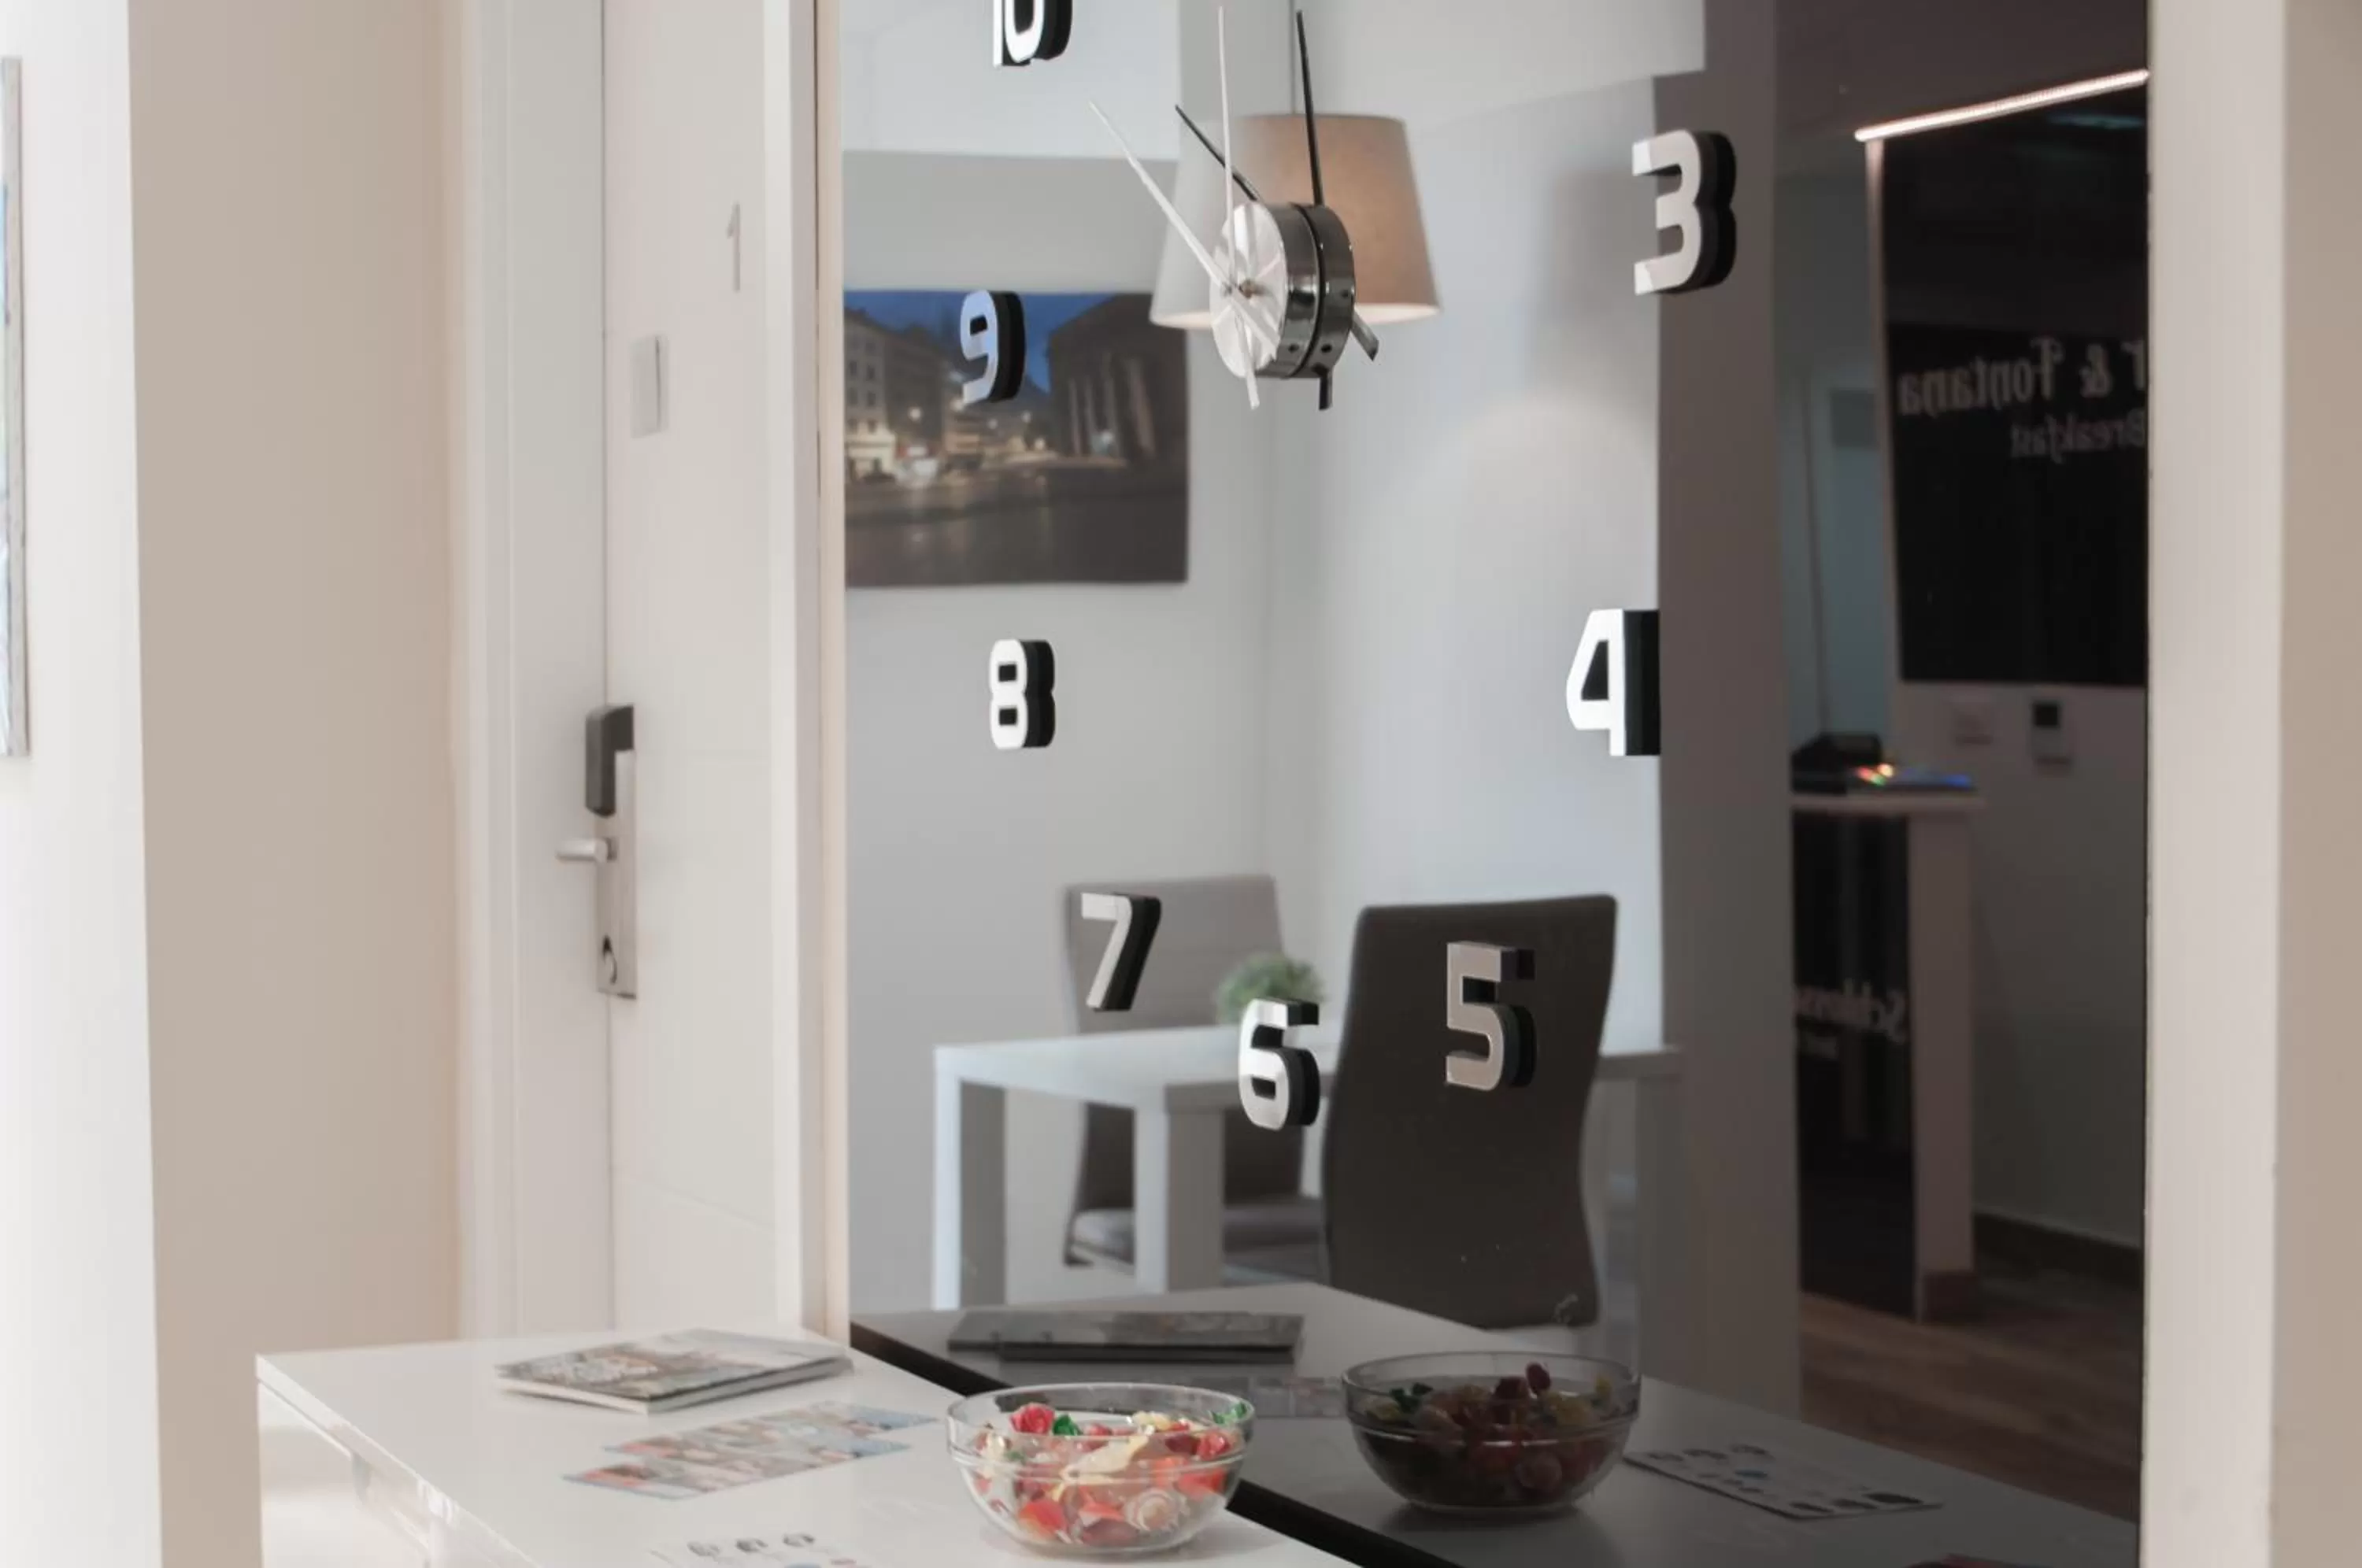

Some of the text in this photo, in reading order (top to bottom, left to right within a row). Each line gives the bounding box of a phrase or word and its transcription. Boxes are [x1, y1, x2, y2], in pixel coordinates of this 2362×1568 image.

[1631, 129, 1705, 294] 3
[960, 290, 1001, 404] 9
[988, 638, 1031, 749] 8
[1565, 608, 1629, 756] 4
[1080, 892, 1135, 1010] 7
[1445, 941, 1508, 1092] 5
[1238, 998, 1294, 1131] 6
